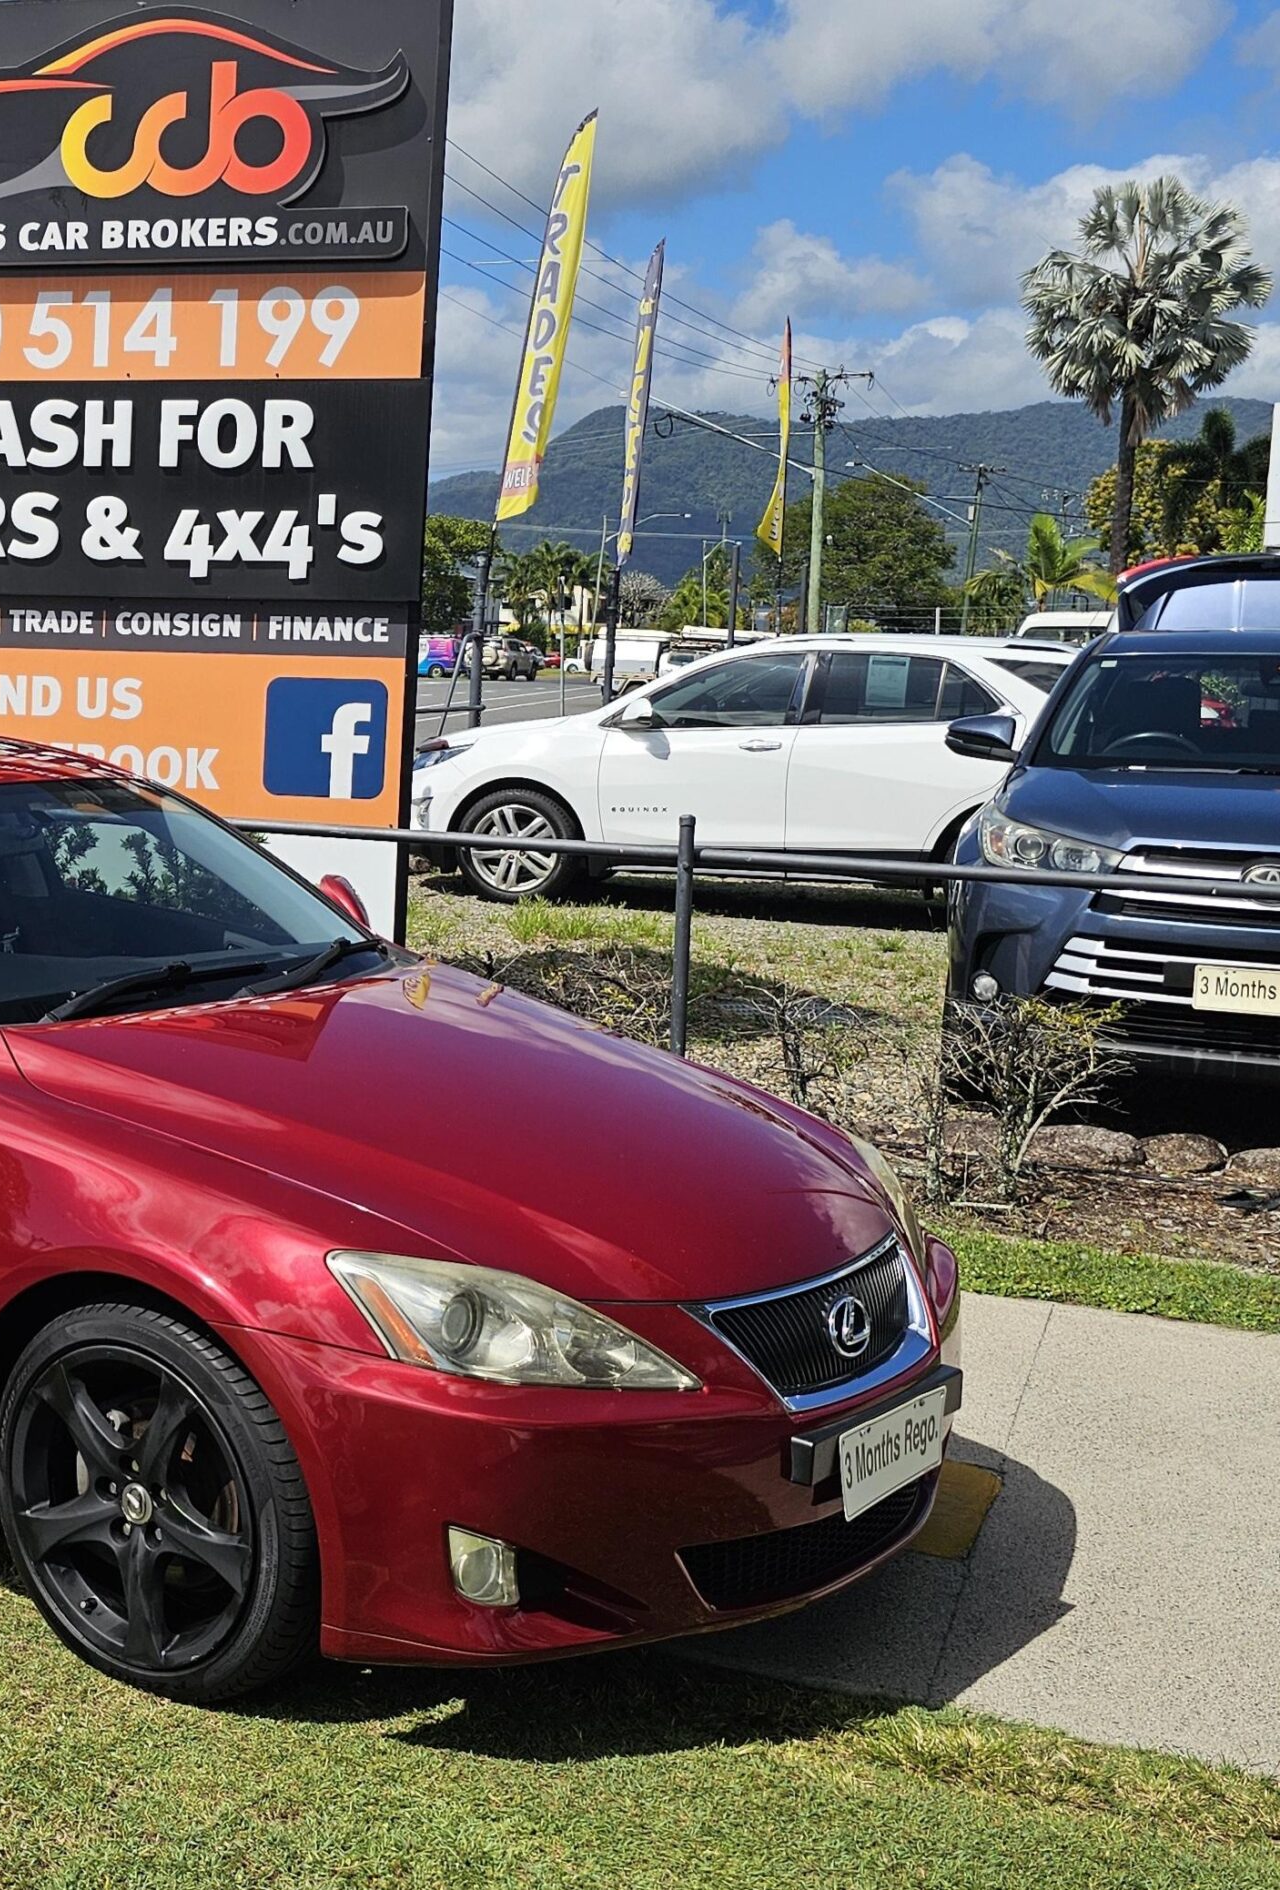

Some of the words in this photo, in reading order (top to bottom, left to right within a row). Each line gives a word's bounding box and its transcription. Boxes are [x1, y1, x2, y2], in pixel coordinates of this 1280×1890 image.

[18, 221, 89, 253] CAR
[22, 287, 177, 368] 514
[210, 286, 361, 368] 199
[158, 400, 315, 469] FOR
[80, 495, 144, 562] &
[9, 610, 94, 635] TRADE
[115, 612, 242, 638] CONSIGN
[267, 615, 390, 643] FINANCE
[76, 677, 143, 720] US
[1199, 975, 1210, 995] 3
[1215, 976, 1278, 1000] Months
[844, 1451, 853, 1489] 3
[856, 1429, 901, 1484] Months
[904, 1414, 939, 1456] Rego.
